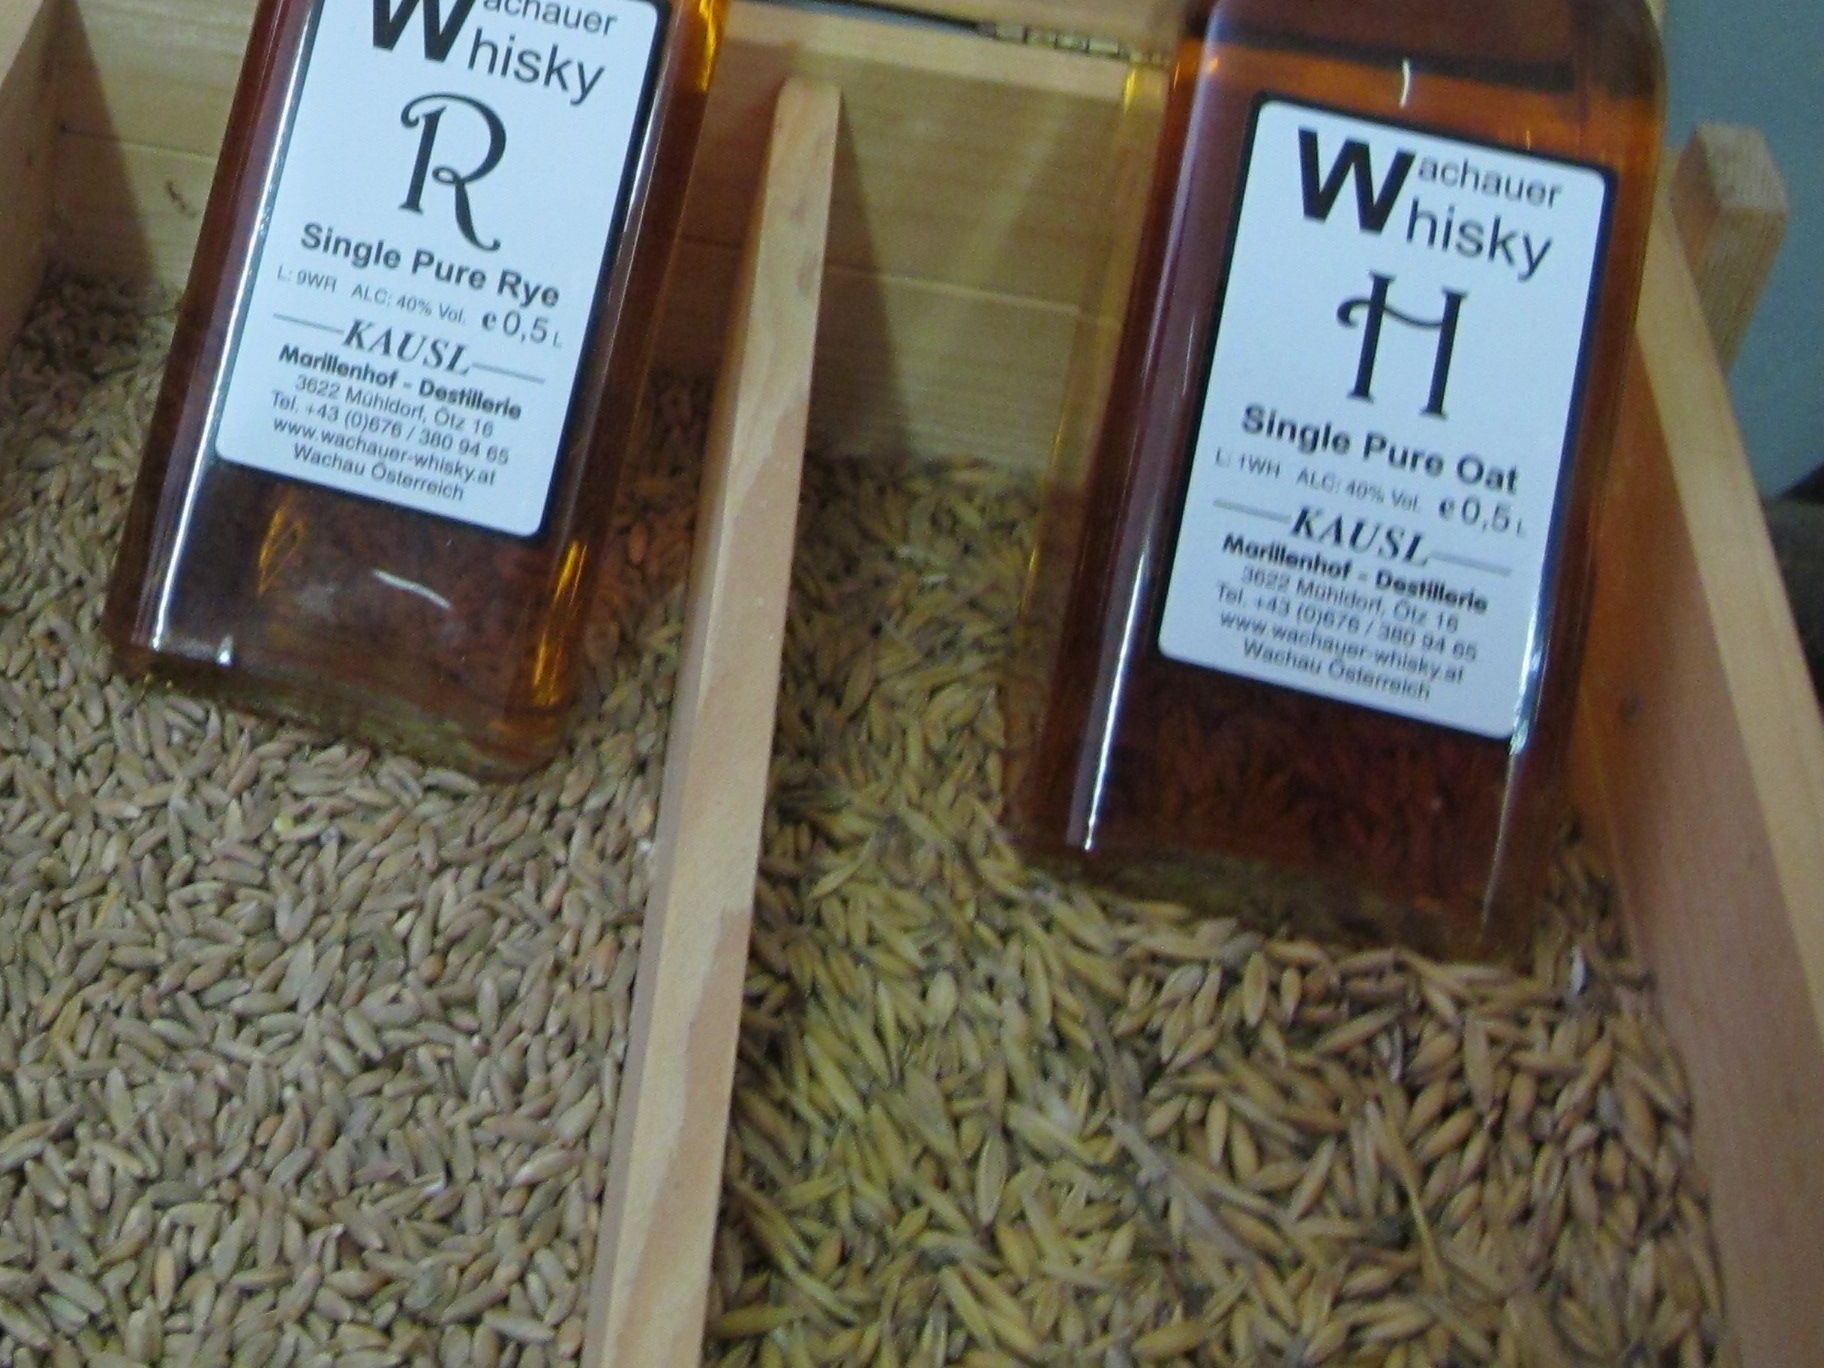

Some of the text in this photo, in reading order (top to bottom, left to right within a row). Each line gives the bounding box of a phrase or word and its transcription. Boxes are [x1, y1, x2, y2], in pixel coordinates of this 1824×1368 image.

[398, 90, 507, 252] R
[1298, 125, 1564, 236] Wachauer
[300, 222, 560, 309] Single Pure Rye
[395, 294, 433, 317] 40%
[438, 302, 467, 325] Vol.
[343, 317, 472, 376] KAUSL
[1336, 268, 1469, 422] H
[278, 343, 399, 389] Marillenhof
[418, 378, 522, 420] Destillerie
[295, 374, 341, 400] 3622
[434, 406, 466, 432] Ötz
[473, 420, 494, 439] 16
[271, 390, 299, 414] Tel.
[304, 400, 340, 423] +43
[343, 409, 404, 440] (0)676
[418, 426, 454, 450] 380
[458, 439, 482, 459] 94
[485, 446, 510, 466] 65
[272, 418, 497, 486] www.wachauer-whisky.at
[1241, 402, 1520, 496] Single Pure Oat
[292, 442, 465, 502] Wachau Österreich
[1345, 479, 1385, 504] 40%
[1290, 505, 1429, 567] KAUSL
[1222, 532, 1354, 581] Marillenhof
[1376, 568, 1489, 614] Destillerie
[1436, 611, 1460, 633] 16
[1242, 637, 1322, 676] Wachau
